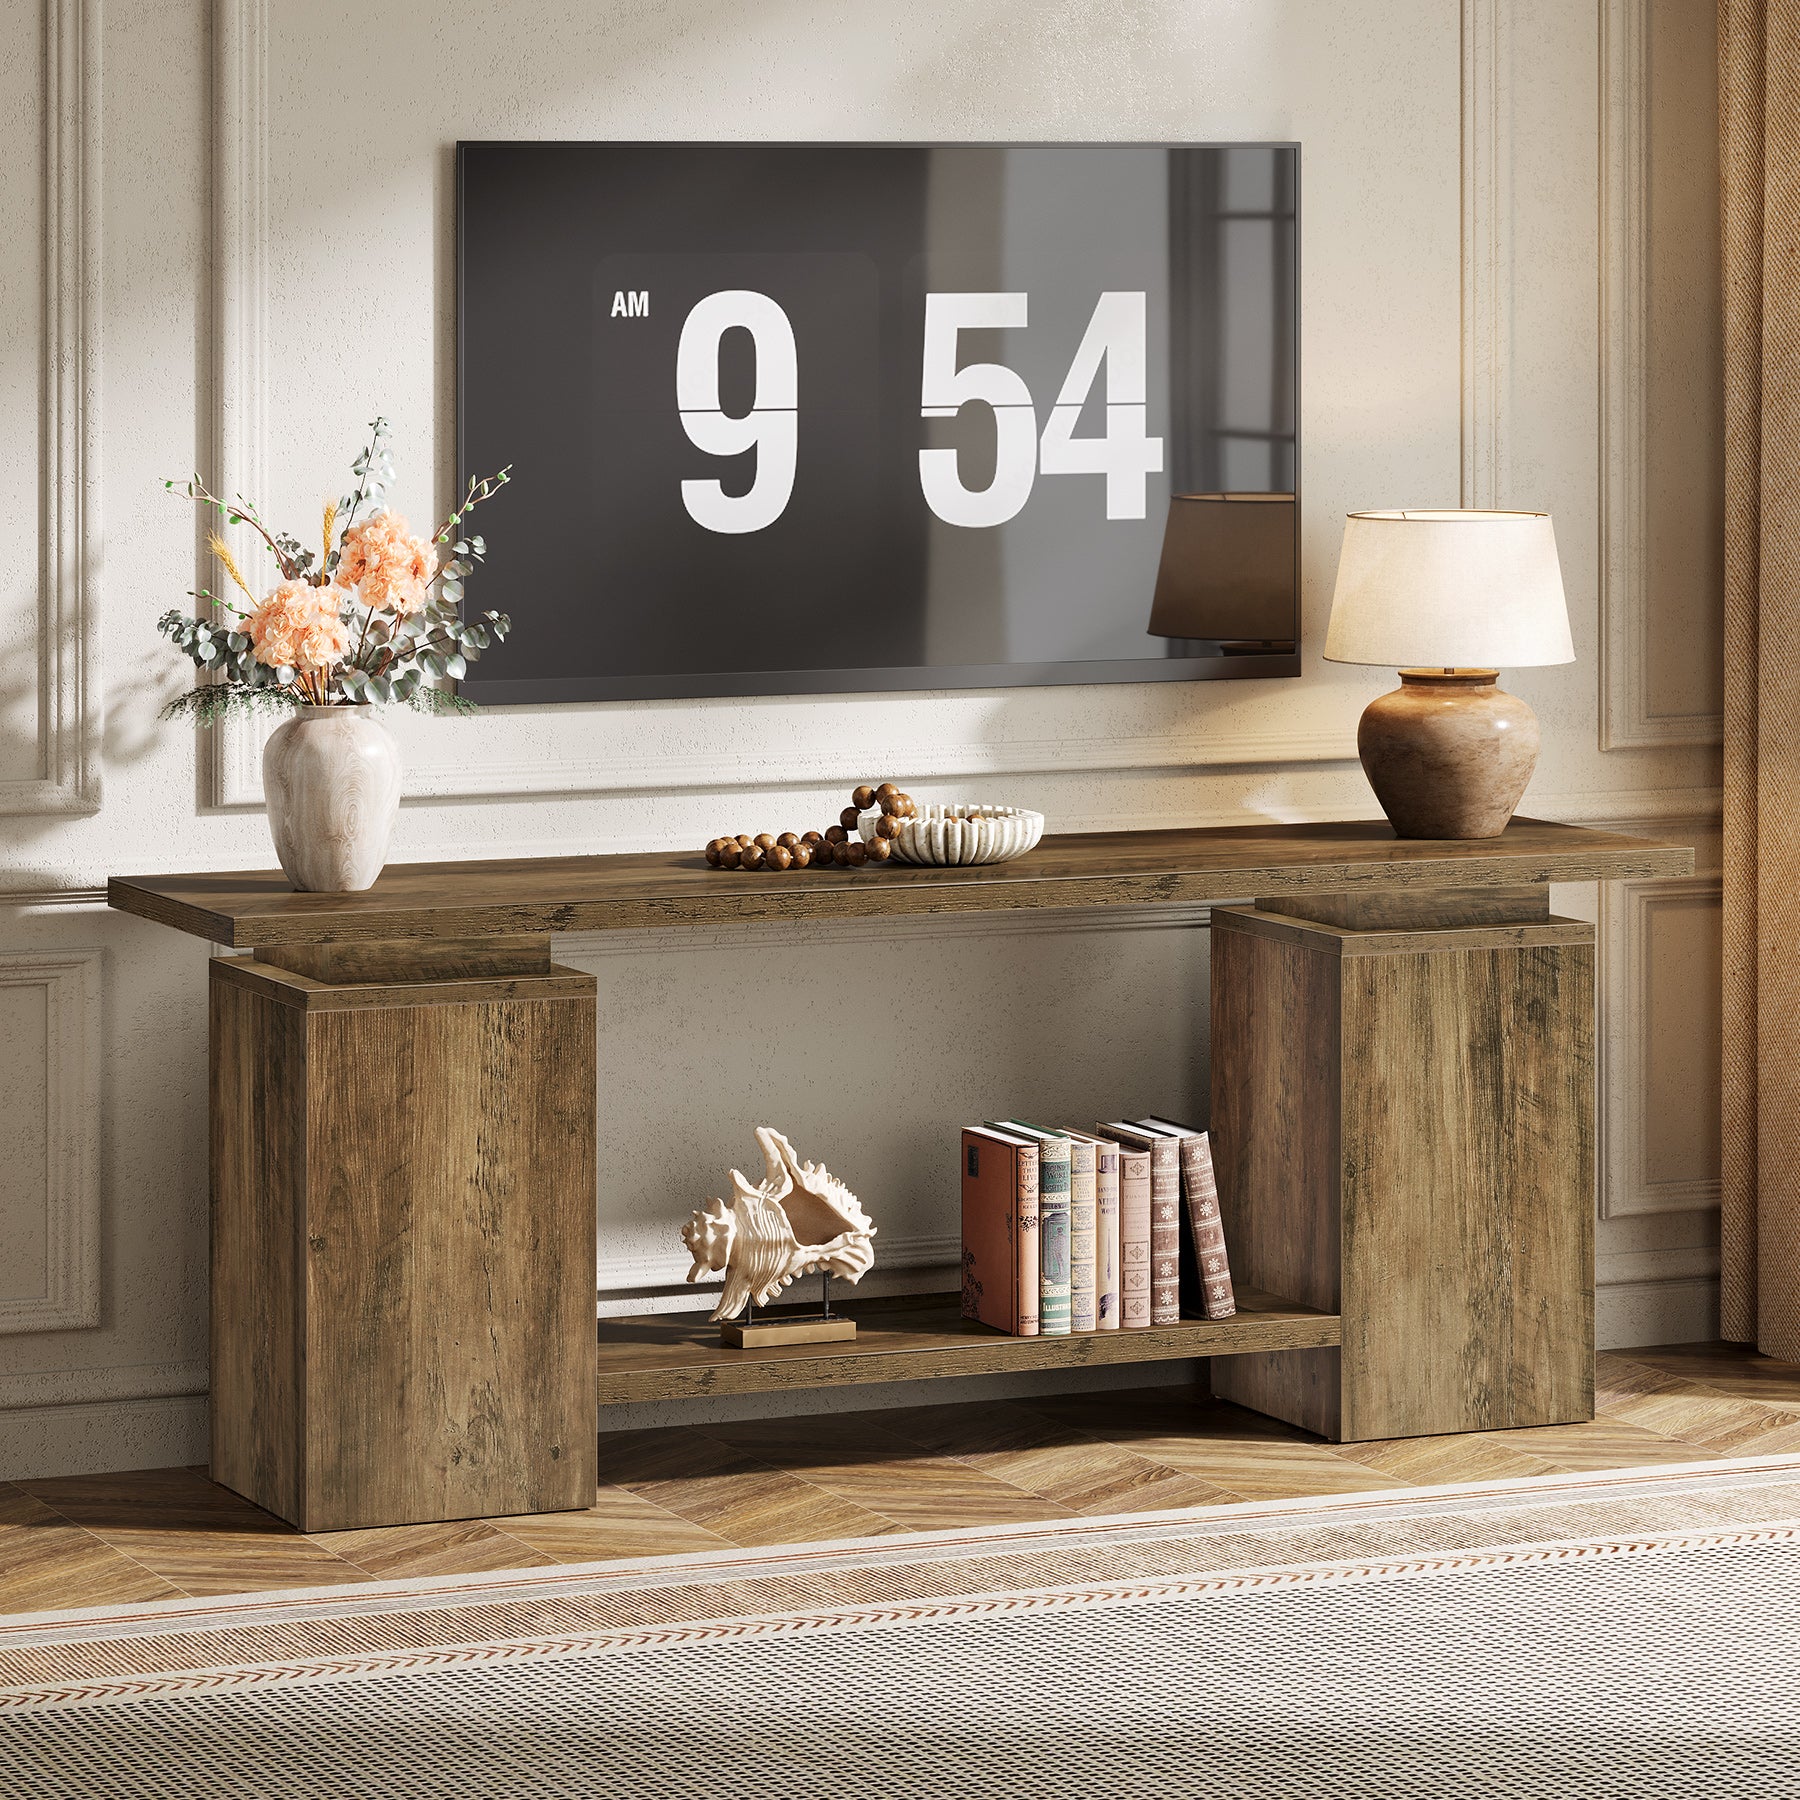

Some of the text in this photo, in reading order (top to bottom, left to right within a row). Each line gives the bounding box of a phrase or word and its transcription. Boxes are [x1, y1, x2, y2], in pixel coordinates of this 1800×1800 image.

[611, 290, 1163, 533] AM 9 54
